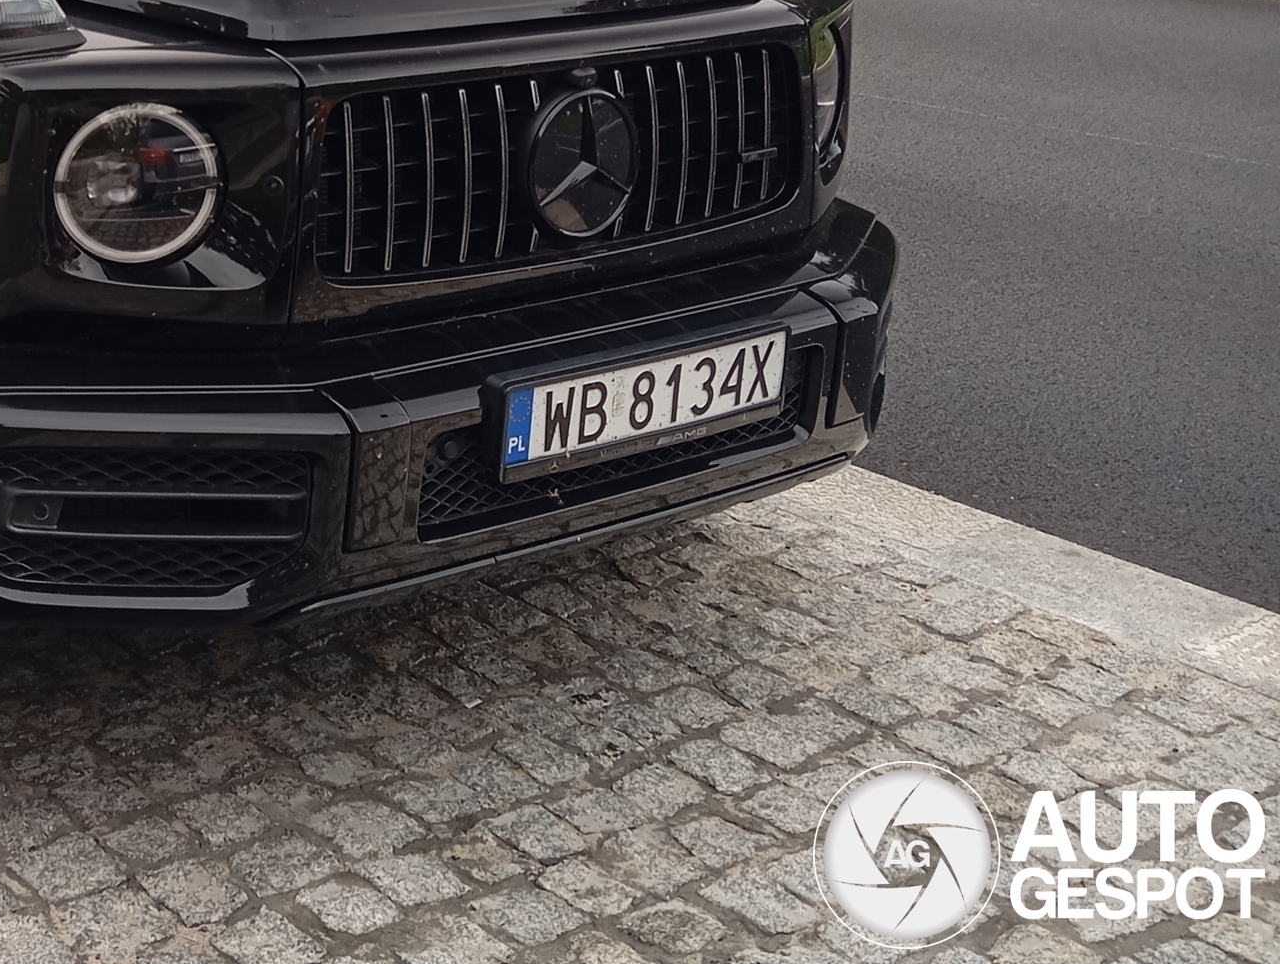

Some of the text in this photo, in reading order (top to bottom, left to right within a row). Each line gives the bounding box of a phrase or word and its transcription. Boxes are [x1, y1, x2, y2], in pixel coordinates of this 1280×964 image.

[544, 340, 776, 452] WB 8134X
[671, 426, 707, 442] AMG
[507, 436, 525, 454] PL
